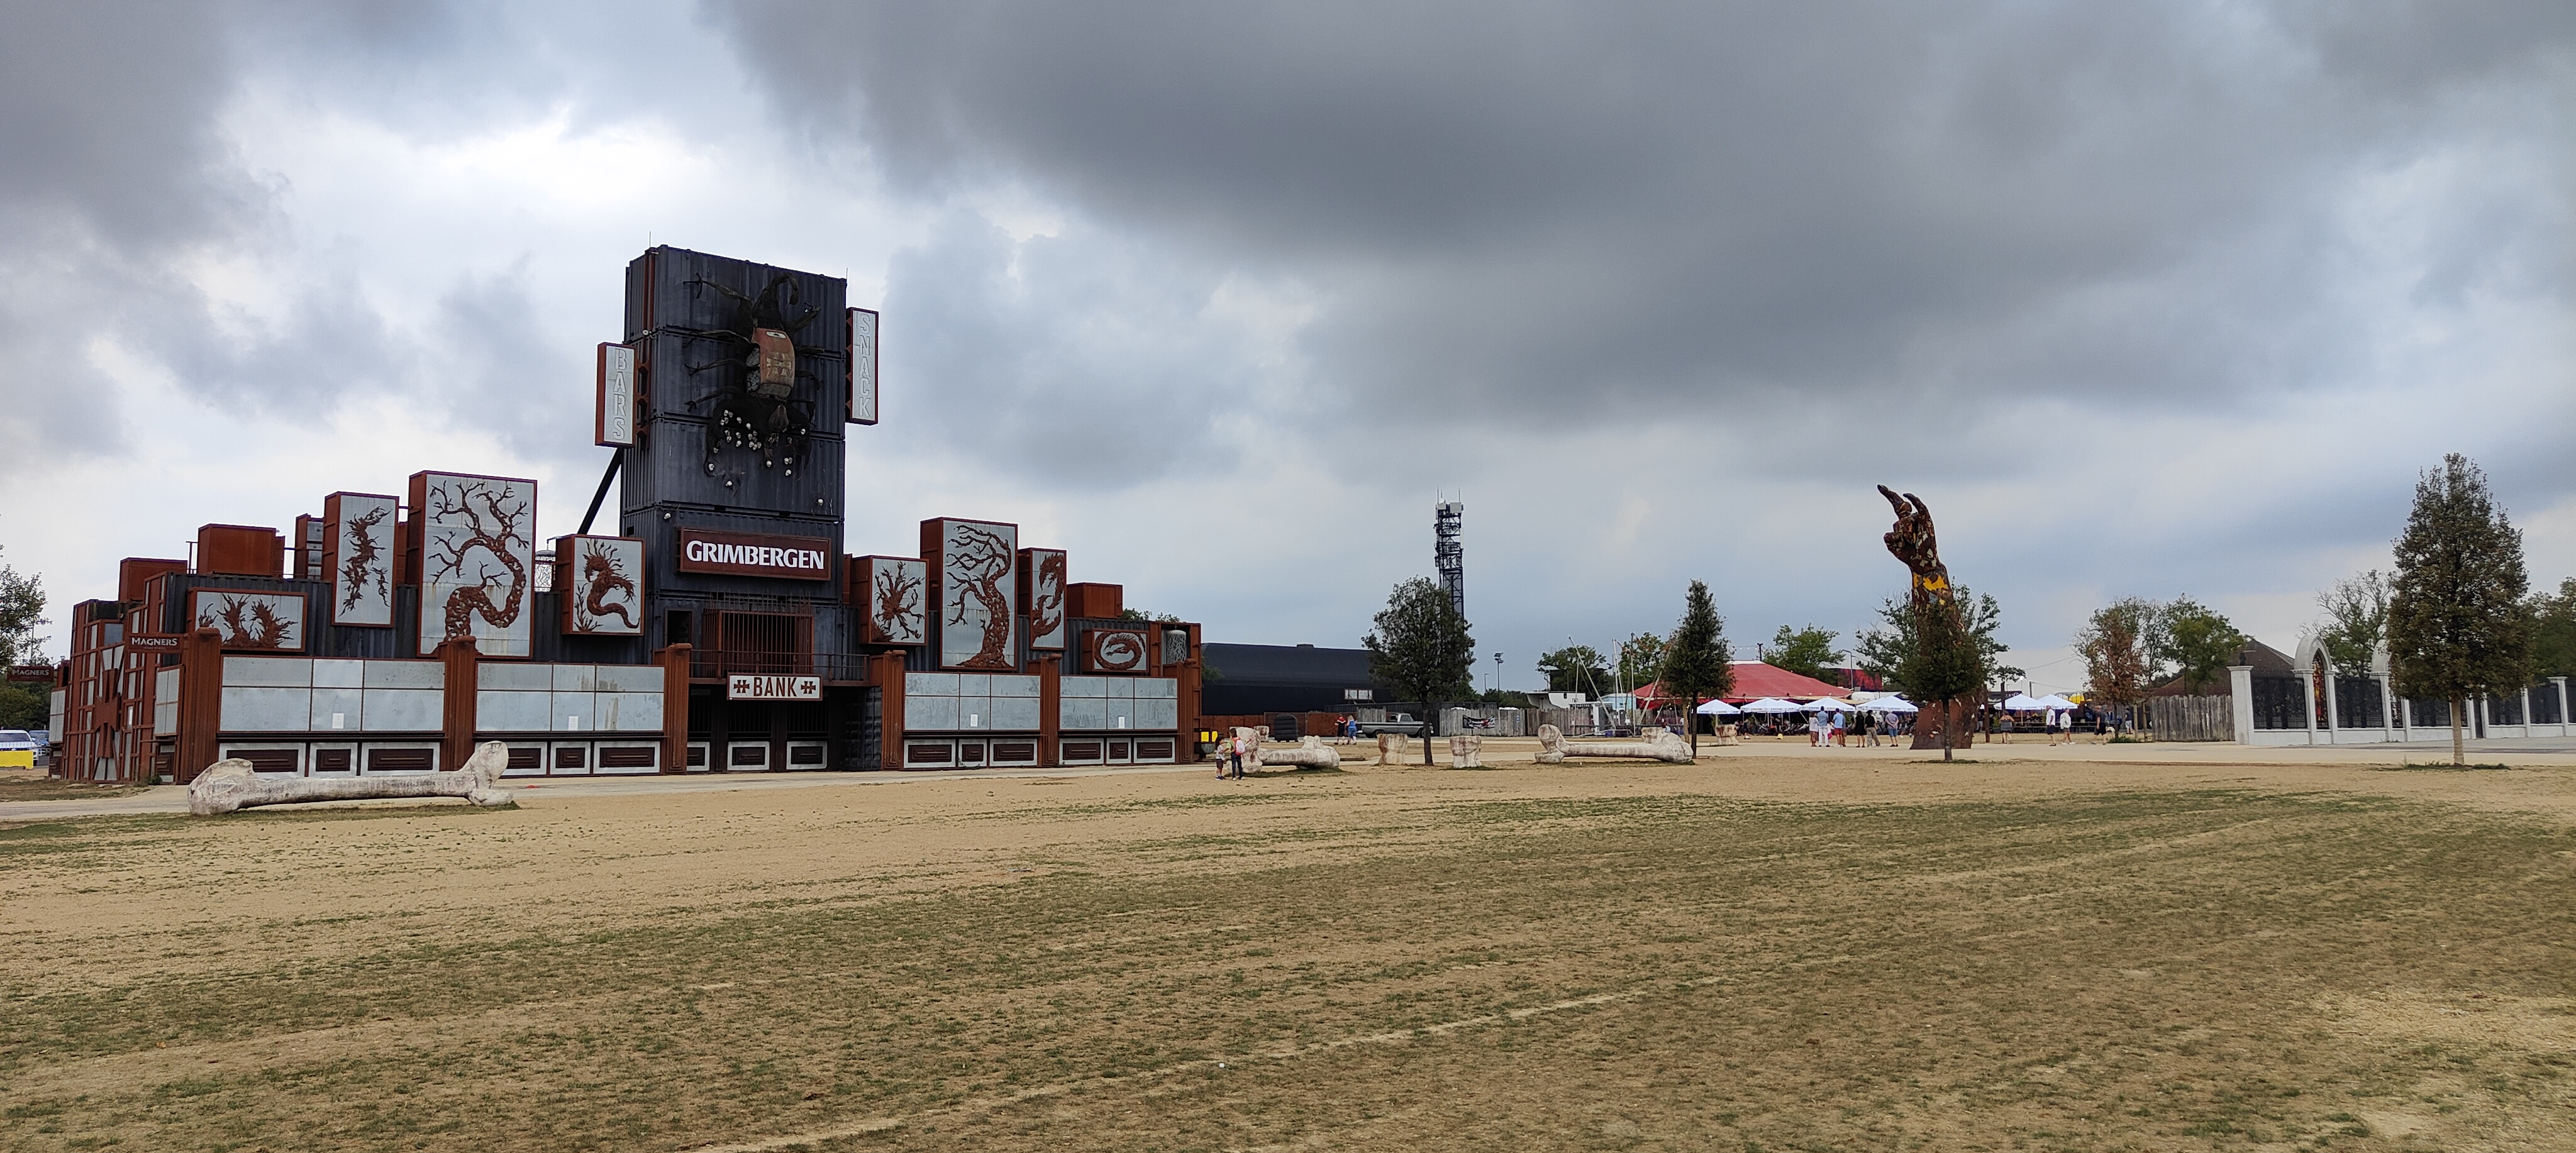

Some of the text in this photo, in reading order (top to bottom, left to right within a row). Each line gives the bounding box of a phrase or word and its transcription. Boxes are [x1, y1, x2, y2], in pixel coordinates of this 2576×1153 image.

[858, 314, 870, 417] SNACK
[613, 348, 627, 440] BARS
[686, 540, 824, 570] GRIMBERGEN
[131, 637, 177, 646] MAGNERS
[753, 677, 797, 697] BANK
